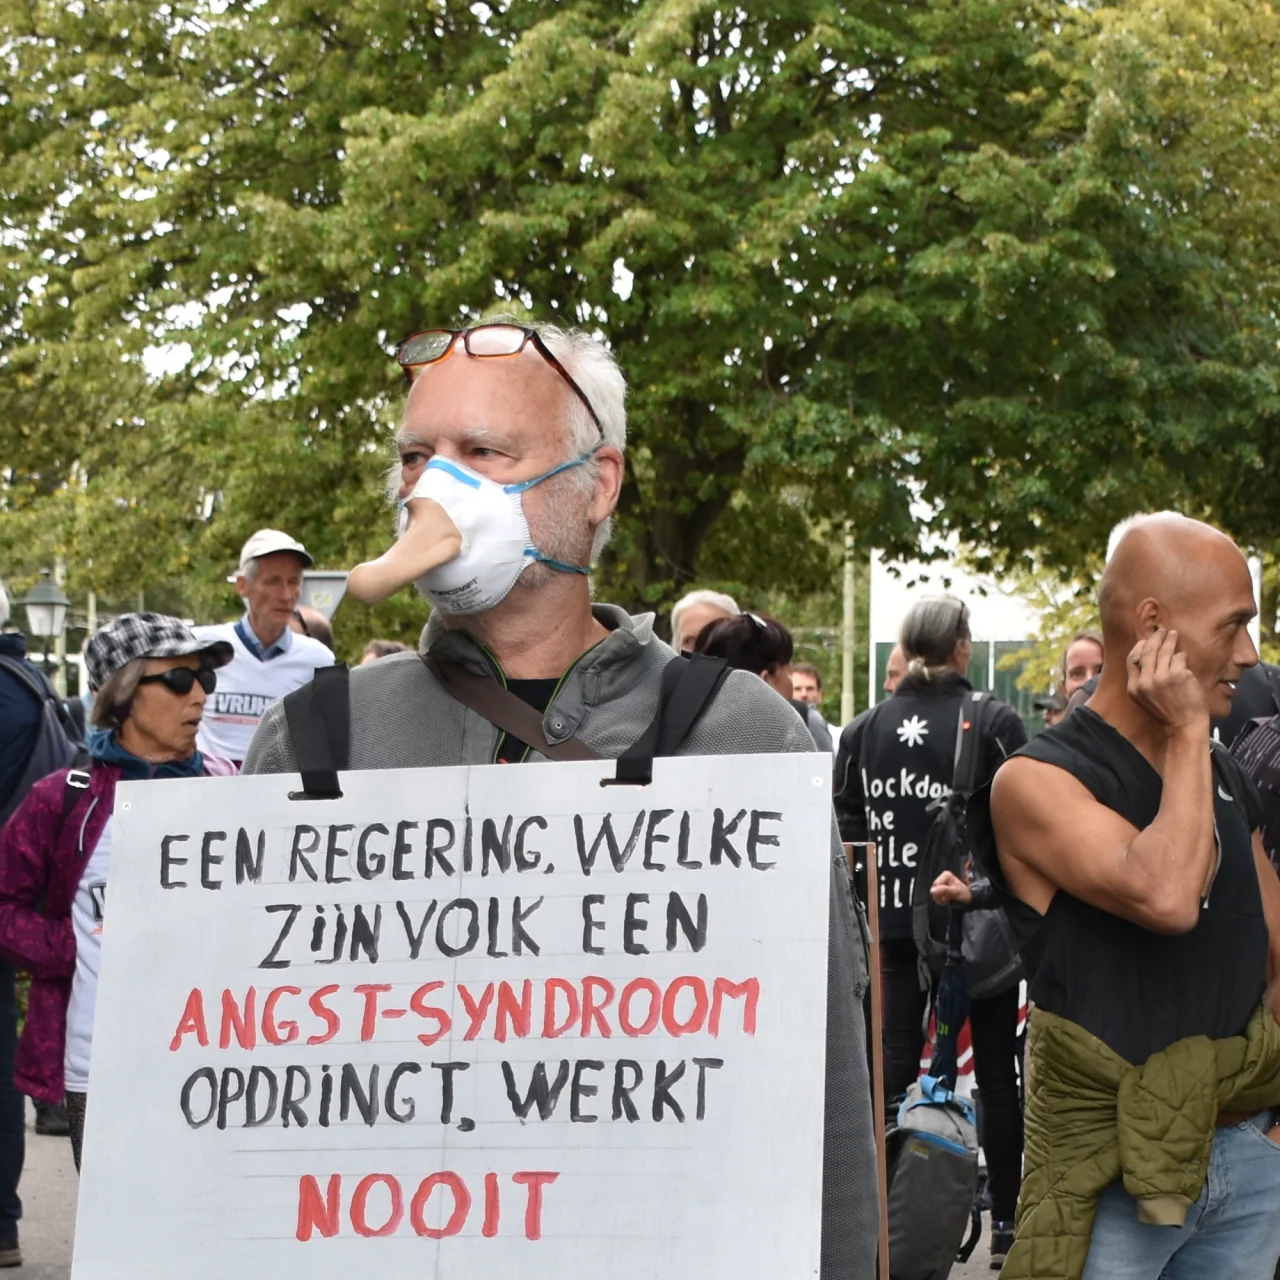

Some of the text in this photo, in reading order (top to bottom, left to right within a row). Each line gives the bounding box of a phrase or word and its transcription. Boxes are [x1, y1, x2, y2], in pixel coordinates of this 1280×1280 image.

[161, 828, 267, 892] EEN
[574, 808, 783, 878] WELKE
[396, 896, 544, 961] VOLK
[583, 892, 709, 957] EEN
[169, 976, 761, 1053] ANGST-SYNDROOM
[502, 1058, 725, 1125] WERKT
[295, 1171, 560, 1243] NOOIT
